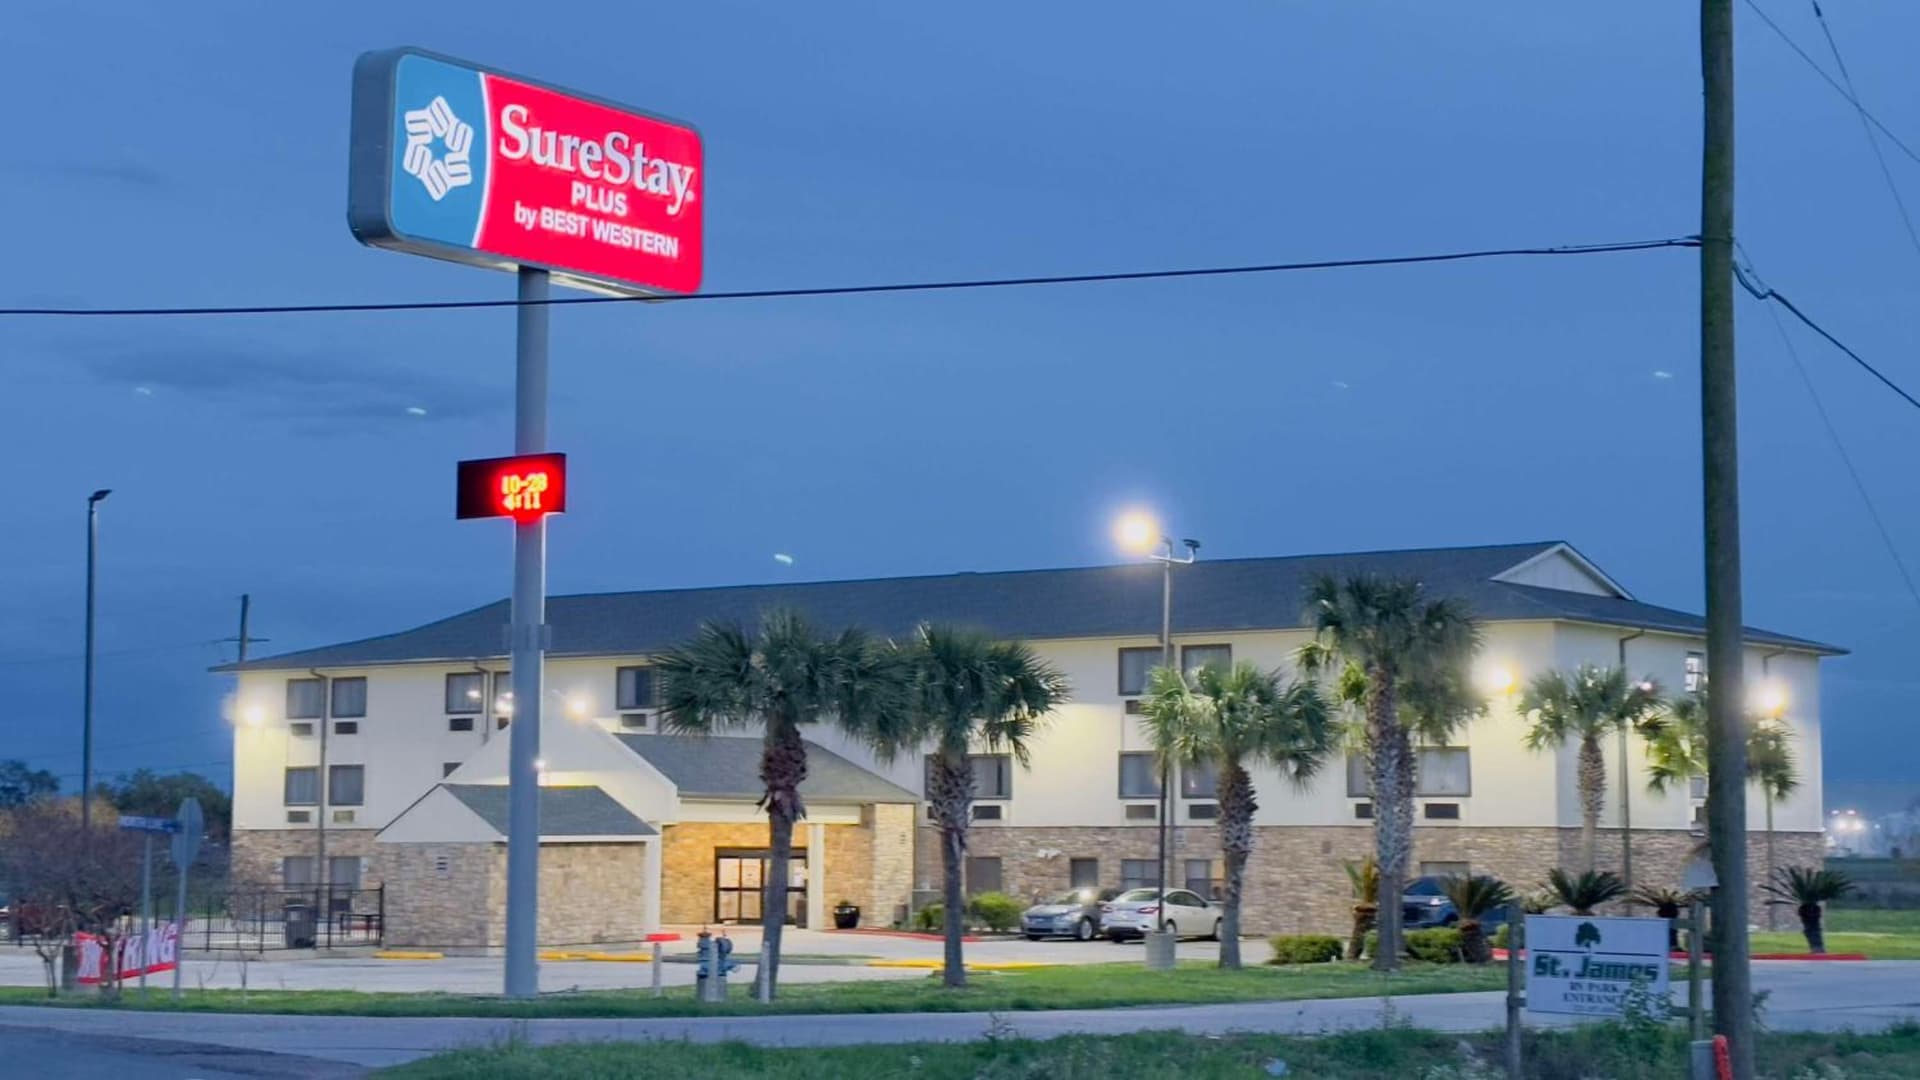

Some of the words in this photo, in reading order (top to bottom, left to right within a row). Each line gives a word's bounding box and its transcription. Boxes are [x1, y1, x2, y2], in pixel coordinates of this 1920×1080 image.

[500, 103, 694, 216] SureStay
[571, 181, 628, 216] PLUS
[514, 201, 538, 231] by
[541, 206, 588, 238] BEST
[591, 218, 679, 259] WESTERN
[1533, 953, 1570, 979] St.
[1587, 982, 1619, 993] PARK
